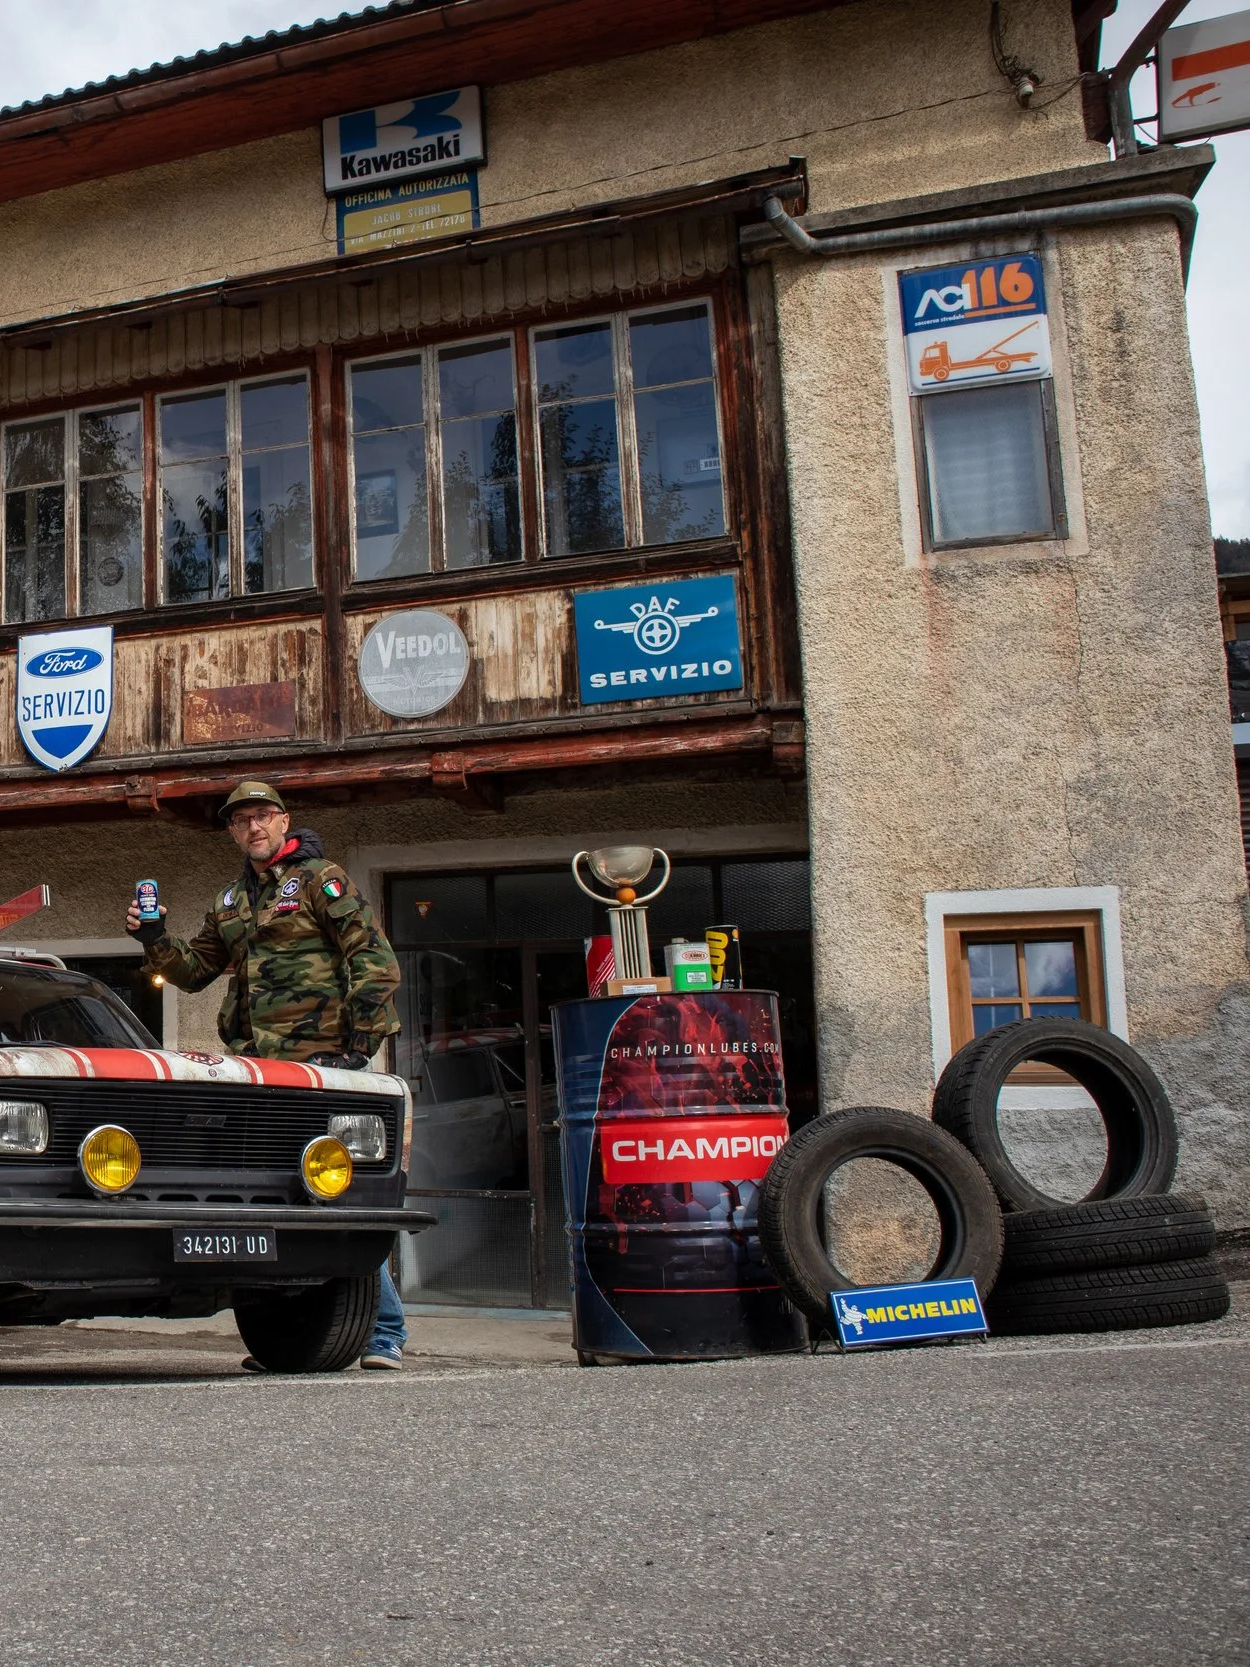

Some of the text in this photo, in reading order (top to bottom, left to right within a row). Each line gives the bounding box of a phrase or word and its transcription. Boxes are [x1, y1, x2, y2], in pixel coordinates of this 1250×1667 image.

[341, 134, 460, 180] Kawasaki
[345, 173, 469, 208] OFFICINA AUTORIZZATA
[961, 262, 1034, 309] 116
[629, 595, 681, 618] DAF
[39, 650, 88, 675] Ford
[374, 631, 461, 668] VEEDOL
[589, 659, 733, 688] SERVIZIO
[22, 688, 105, 722] SERVIZIO
[183, 1236, 268, 1254] 342131 UD
[866, 1297, 977, 1325] MICHELIN
